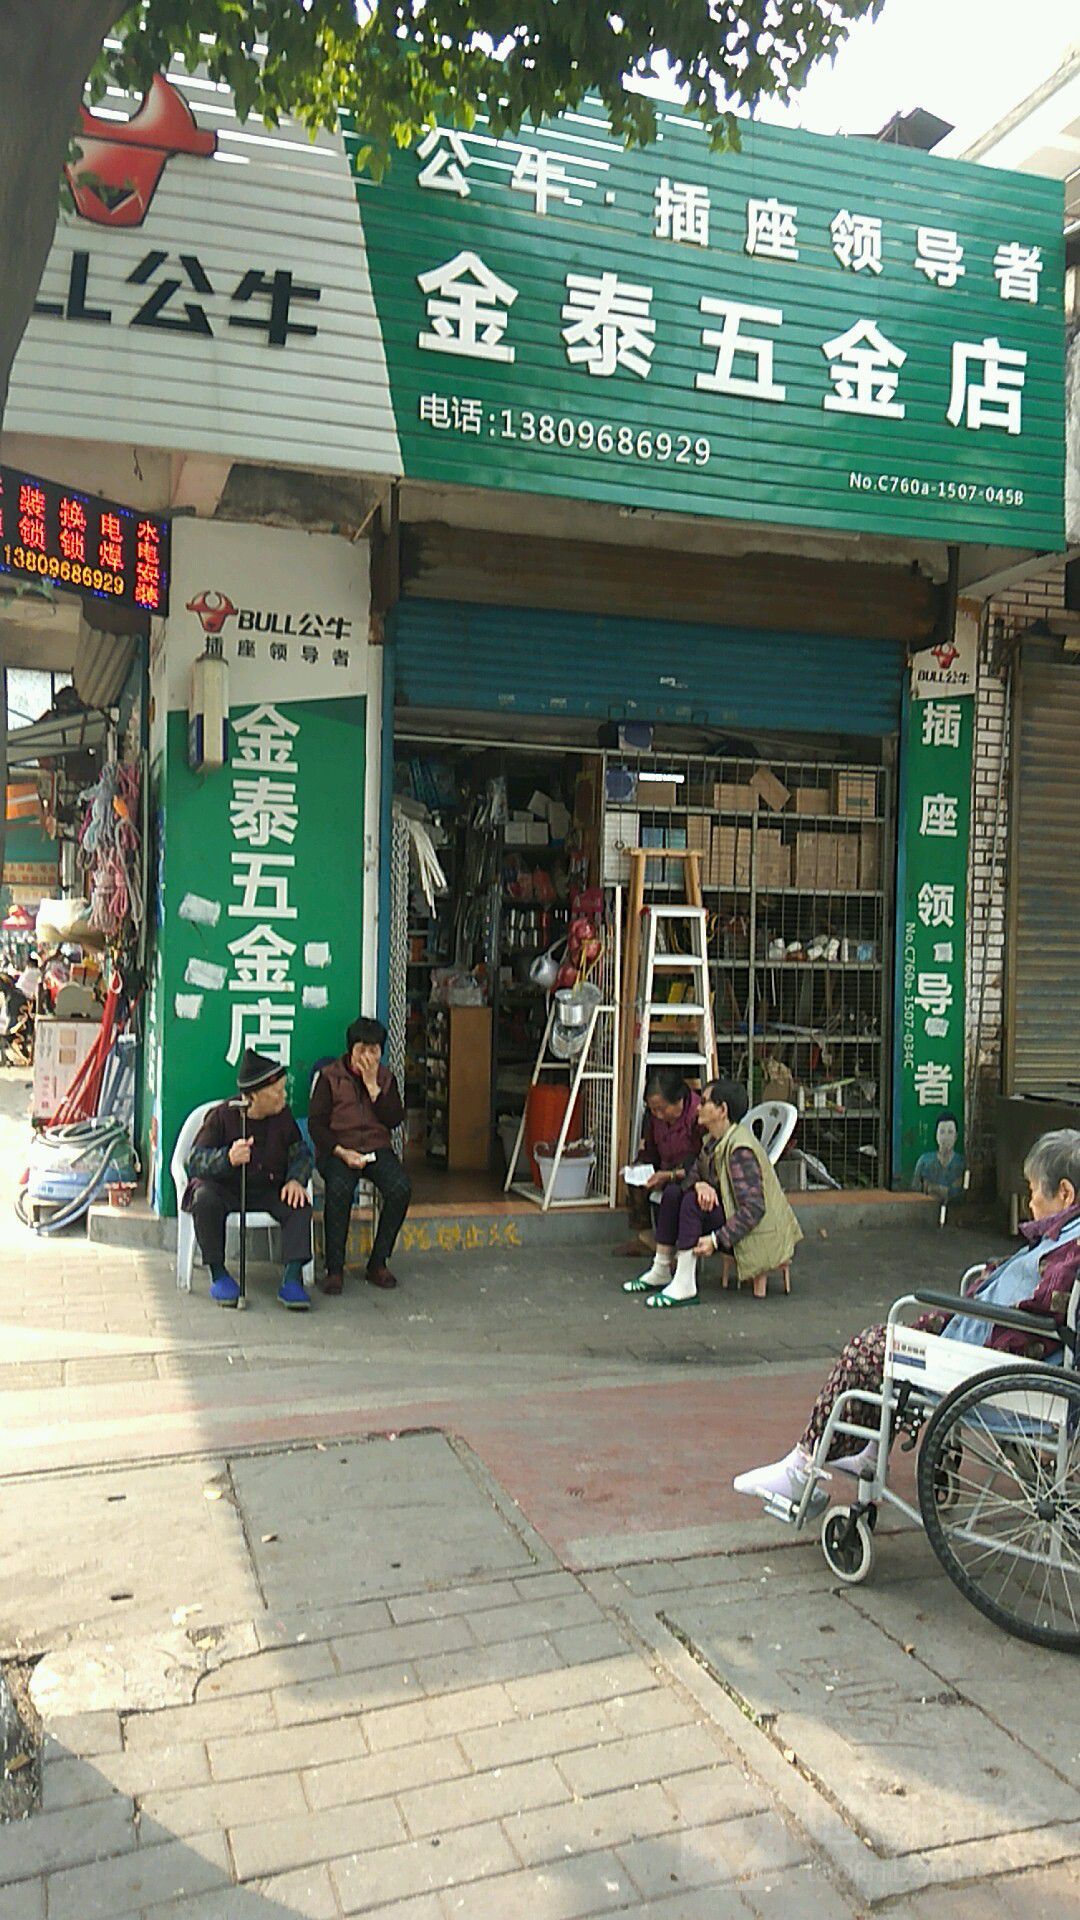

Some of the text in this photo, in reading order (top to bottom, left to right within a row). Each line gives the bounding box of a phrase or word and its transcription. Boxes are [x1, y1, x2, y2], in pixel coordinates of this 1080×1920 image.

[417, 250, 1029, 436] 金泰五金店
[419, 393, 712, 468] 电话:13809686929
[4, 543, 125, 595] 13809686929
[205, 635, 350, 668] 插座领导者
[226, 703, 301, 1067] 金泰五金店
[914, 700, 962, 1107] 插座领导者
